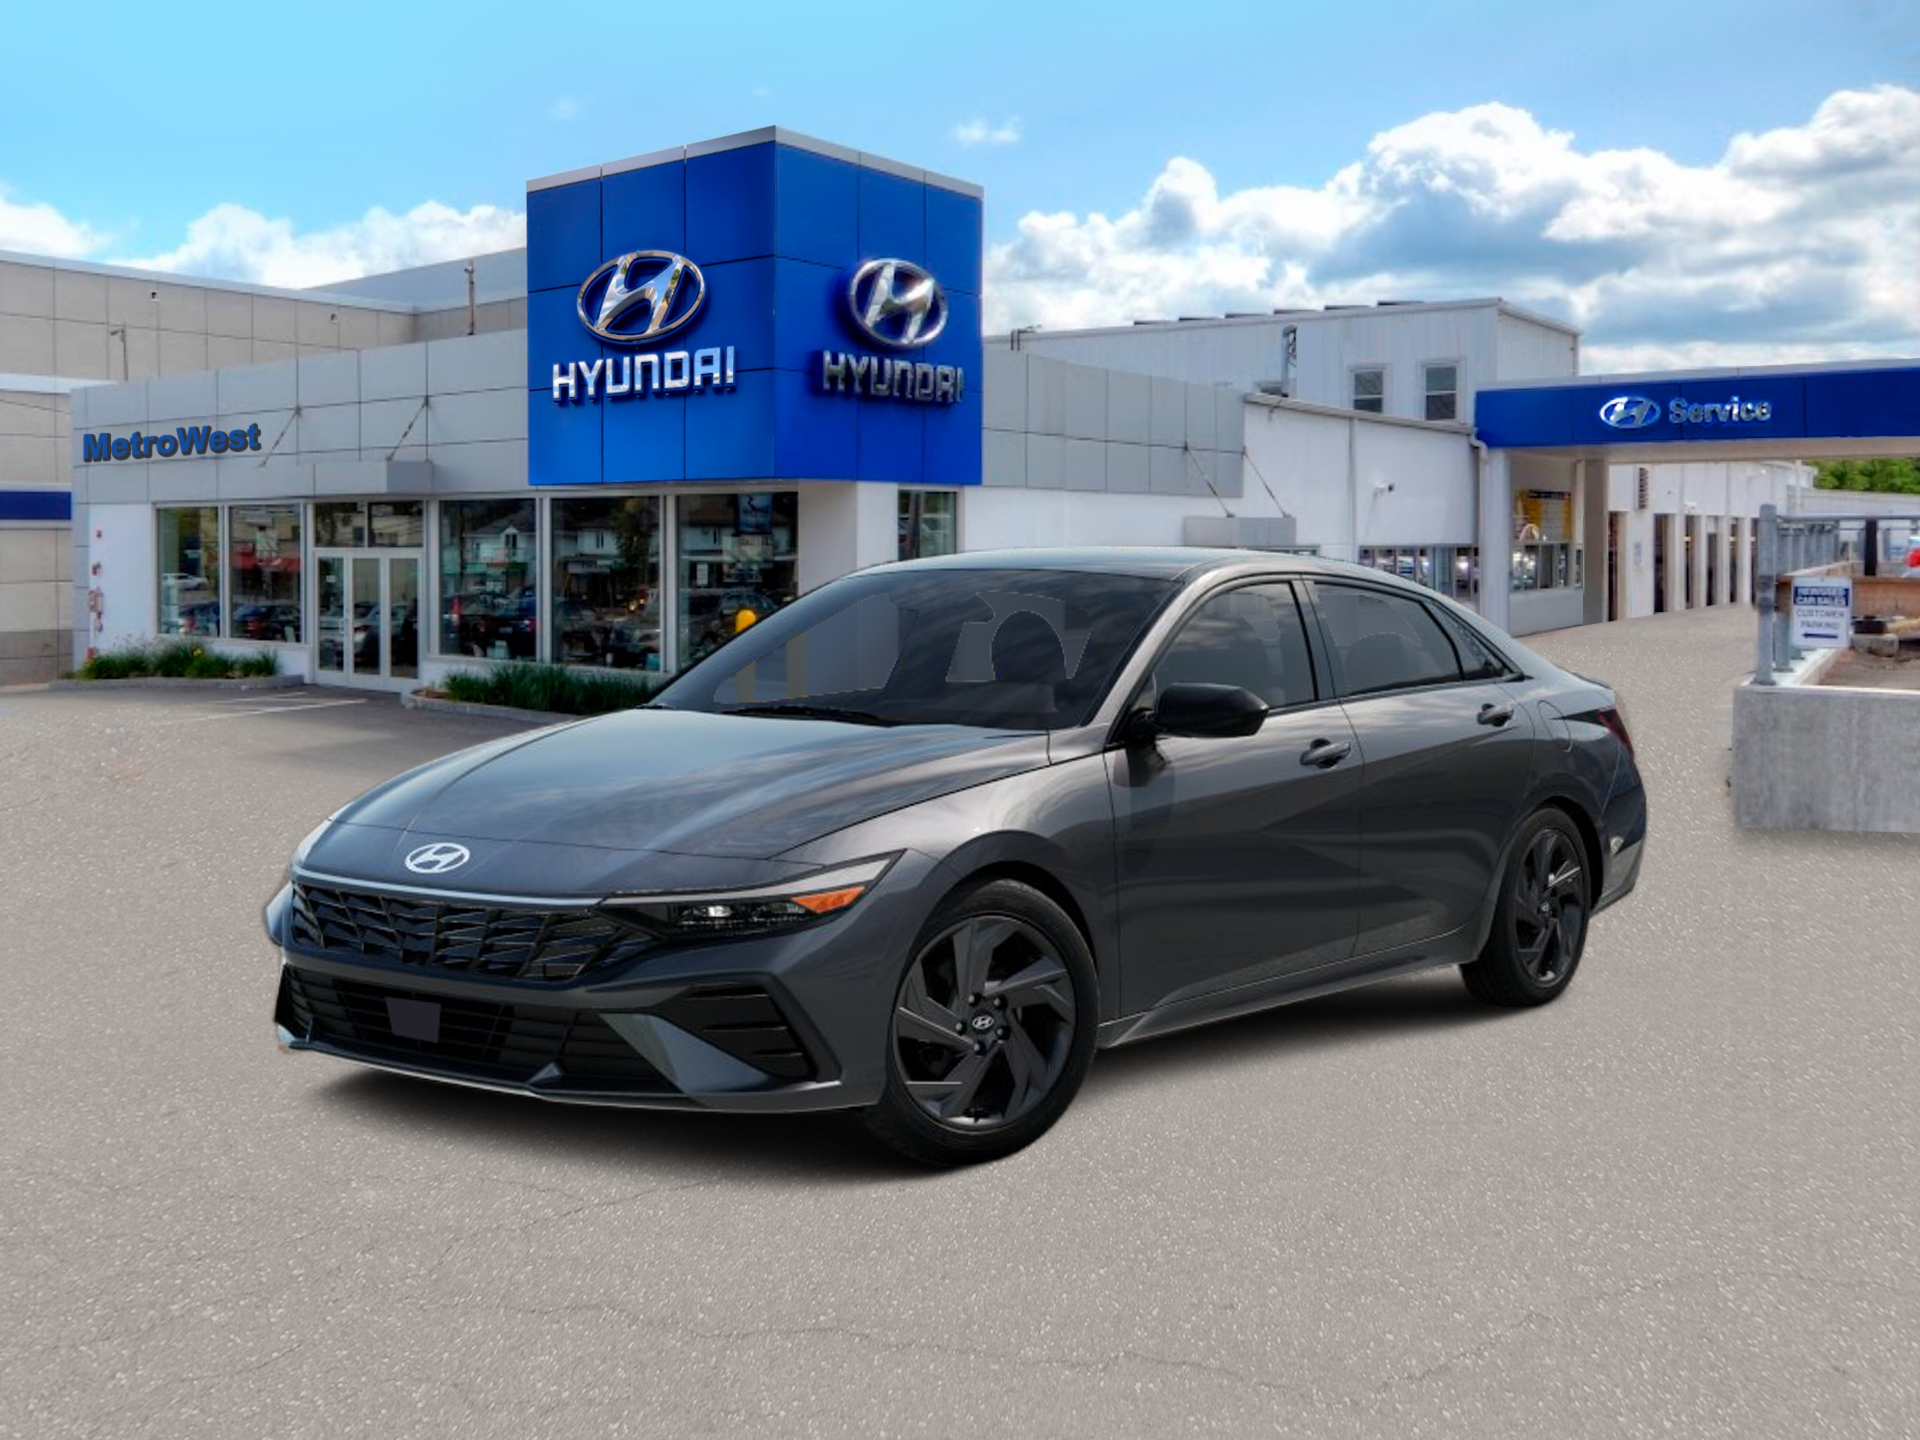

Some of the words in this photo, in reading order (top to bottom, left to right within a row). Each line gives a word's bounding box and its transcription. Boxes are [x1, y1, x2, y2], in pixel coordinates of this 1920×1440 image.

[552, 345, 736, 400] HYUNDAI
[822, 350, 964, 403] HYUNDAI
[1668, 396, 1772, 423] Service
[83, 423, 262, 463] MetroWest
[1796, 609, 1844, 618] CUSTOMER
